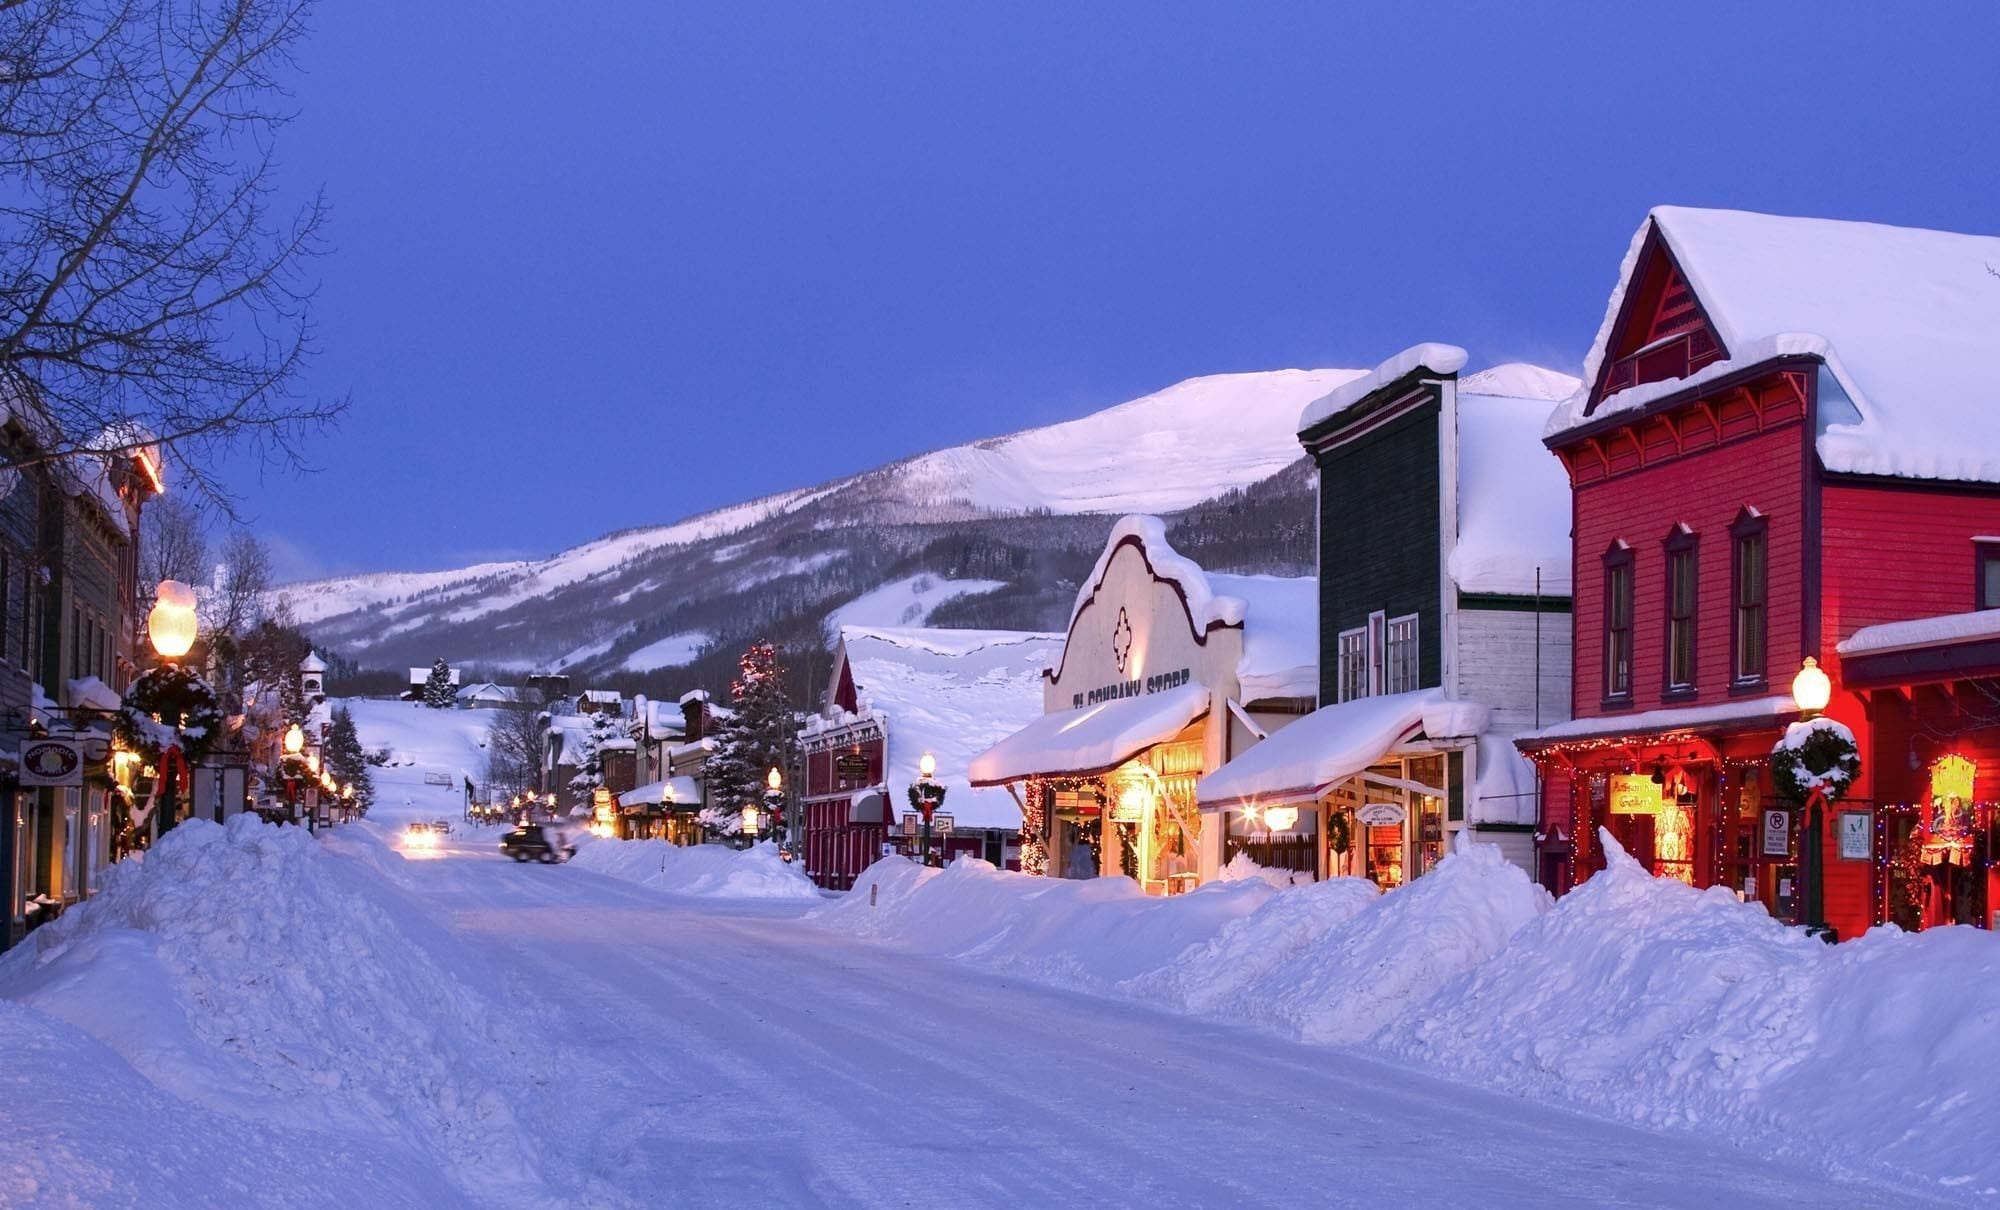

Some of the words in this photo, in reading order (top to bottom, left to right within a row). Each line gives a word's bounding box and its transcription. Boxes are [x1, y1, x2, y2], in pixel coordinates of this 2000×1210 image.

[1088, 679, 1141, 706] COMPANY
[1146, 668, 1190, 695] STORE
[27, 746, 75, 760] NOMADIC
[1614, 781, 1641, 792] Artisan
